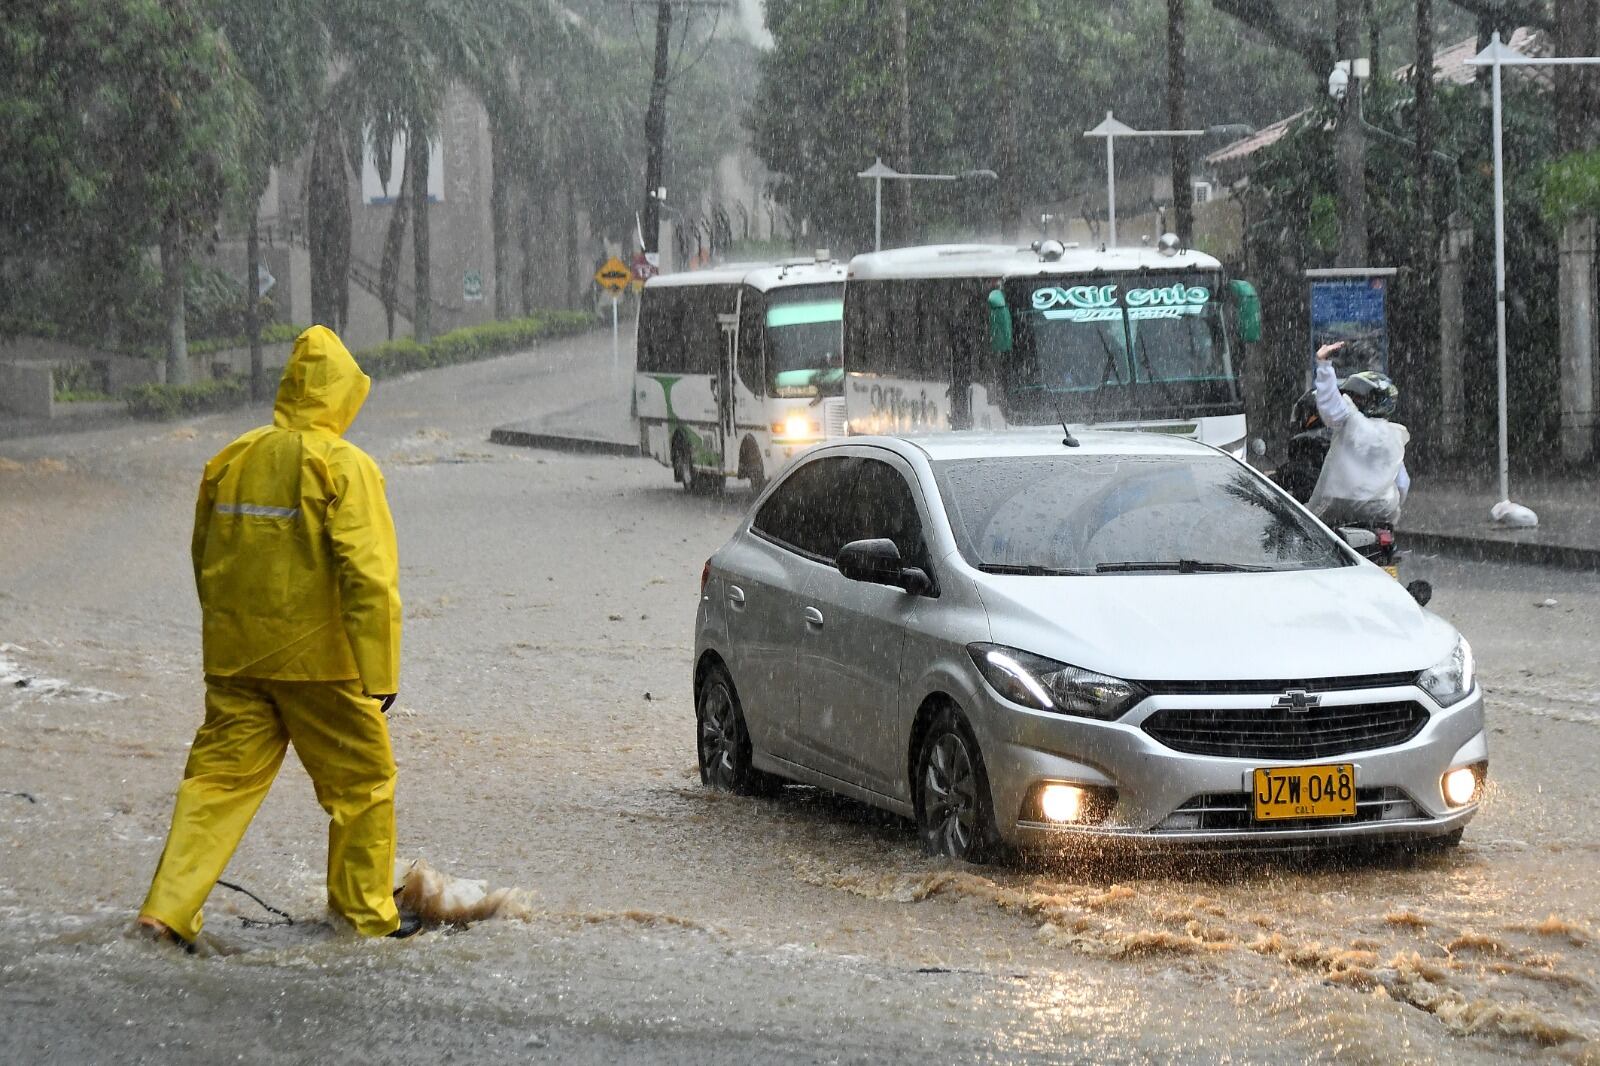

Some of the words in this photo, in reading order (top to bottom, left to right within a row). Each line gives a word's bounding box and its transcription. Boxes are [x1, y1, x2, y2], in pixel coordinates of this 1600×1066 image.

[1259, 776, 1301, 804] JZW
[1309, 774, 1351, 802] 048
[1296, 805, 1316, 814] CALI
